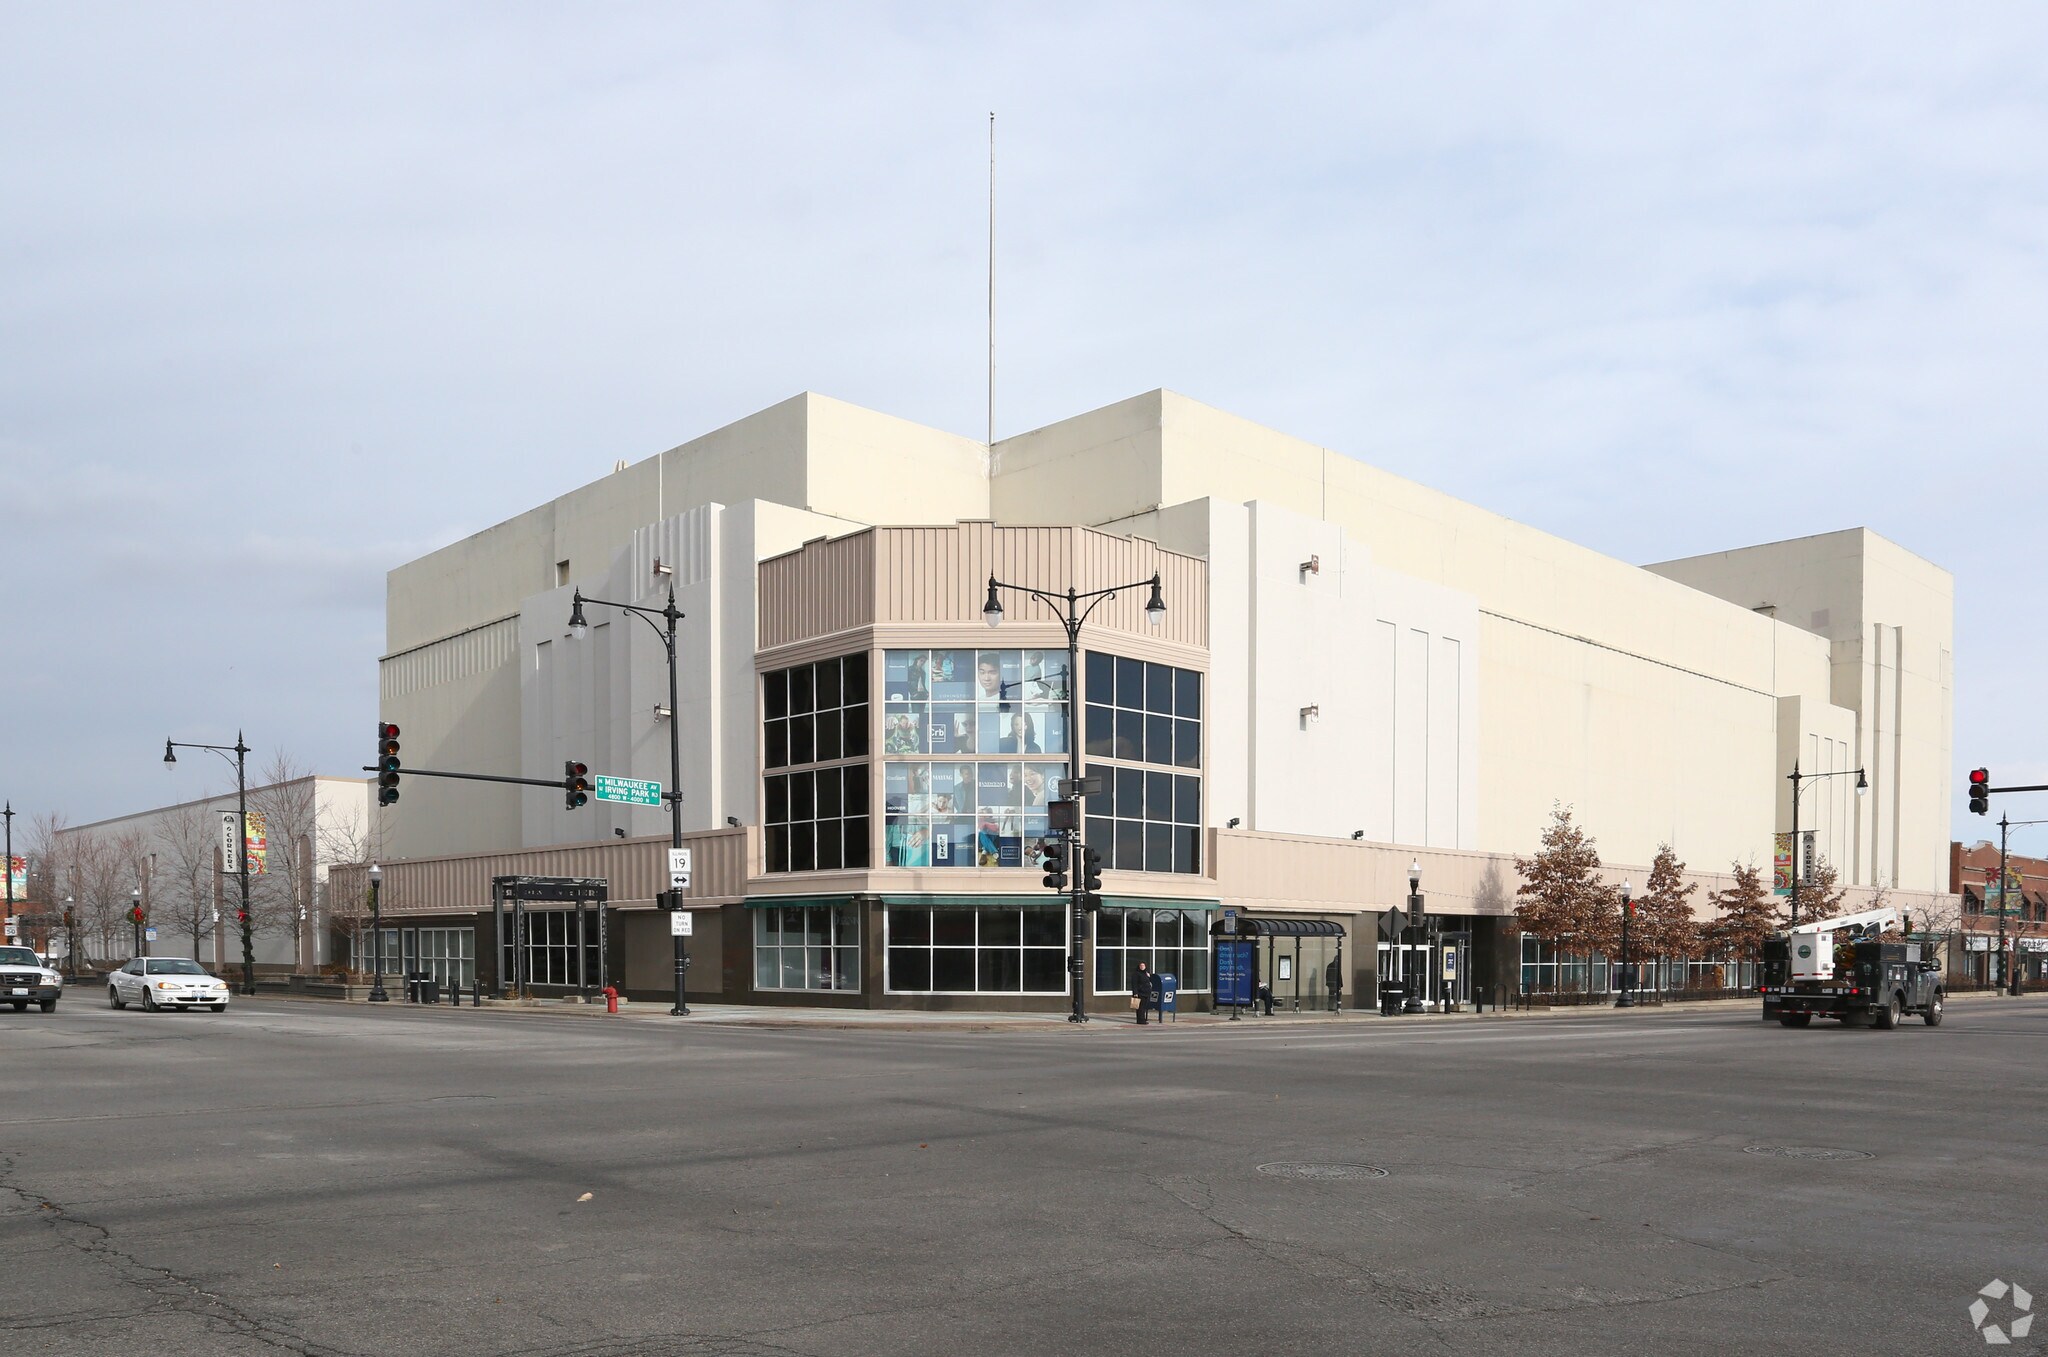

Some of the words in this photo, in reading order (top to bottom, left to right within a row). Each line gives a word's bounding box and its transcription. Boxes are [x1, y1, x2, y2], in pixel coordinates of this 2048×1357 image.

[604, 778, 648, 790] MILWAUKEE
[604, 786, 628, 796] IRVING
[631, 789, 649, 798] PARK
[674, 858, 686, 869] 19
